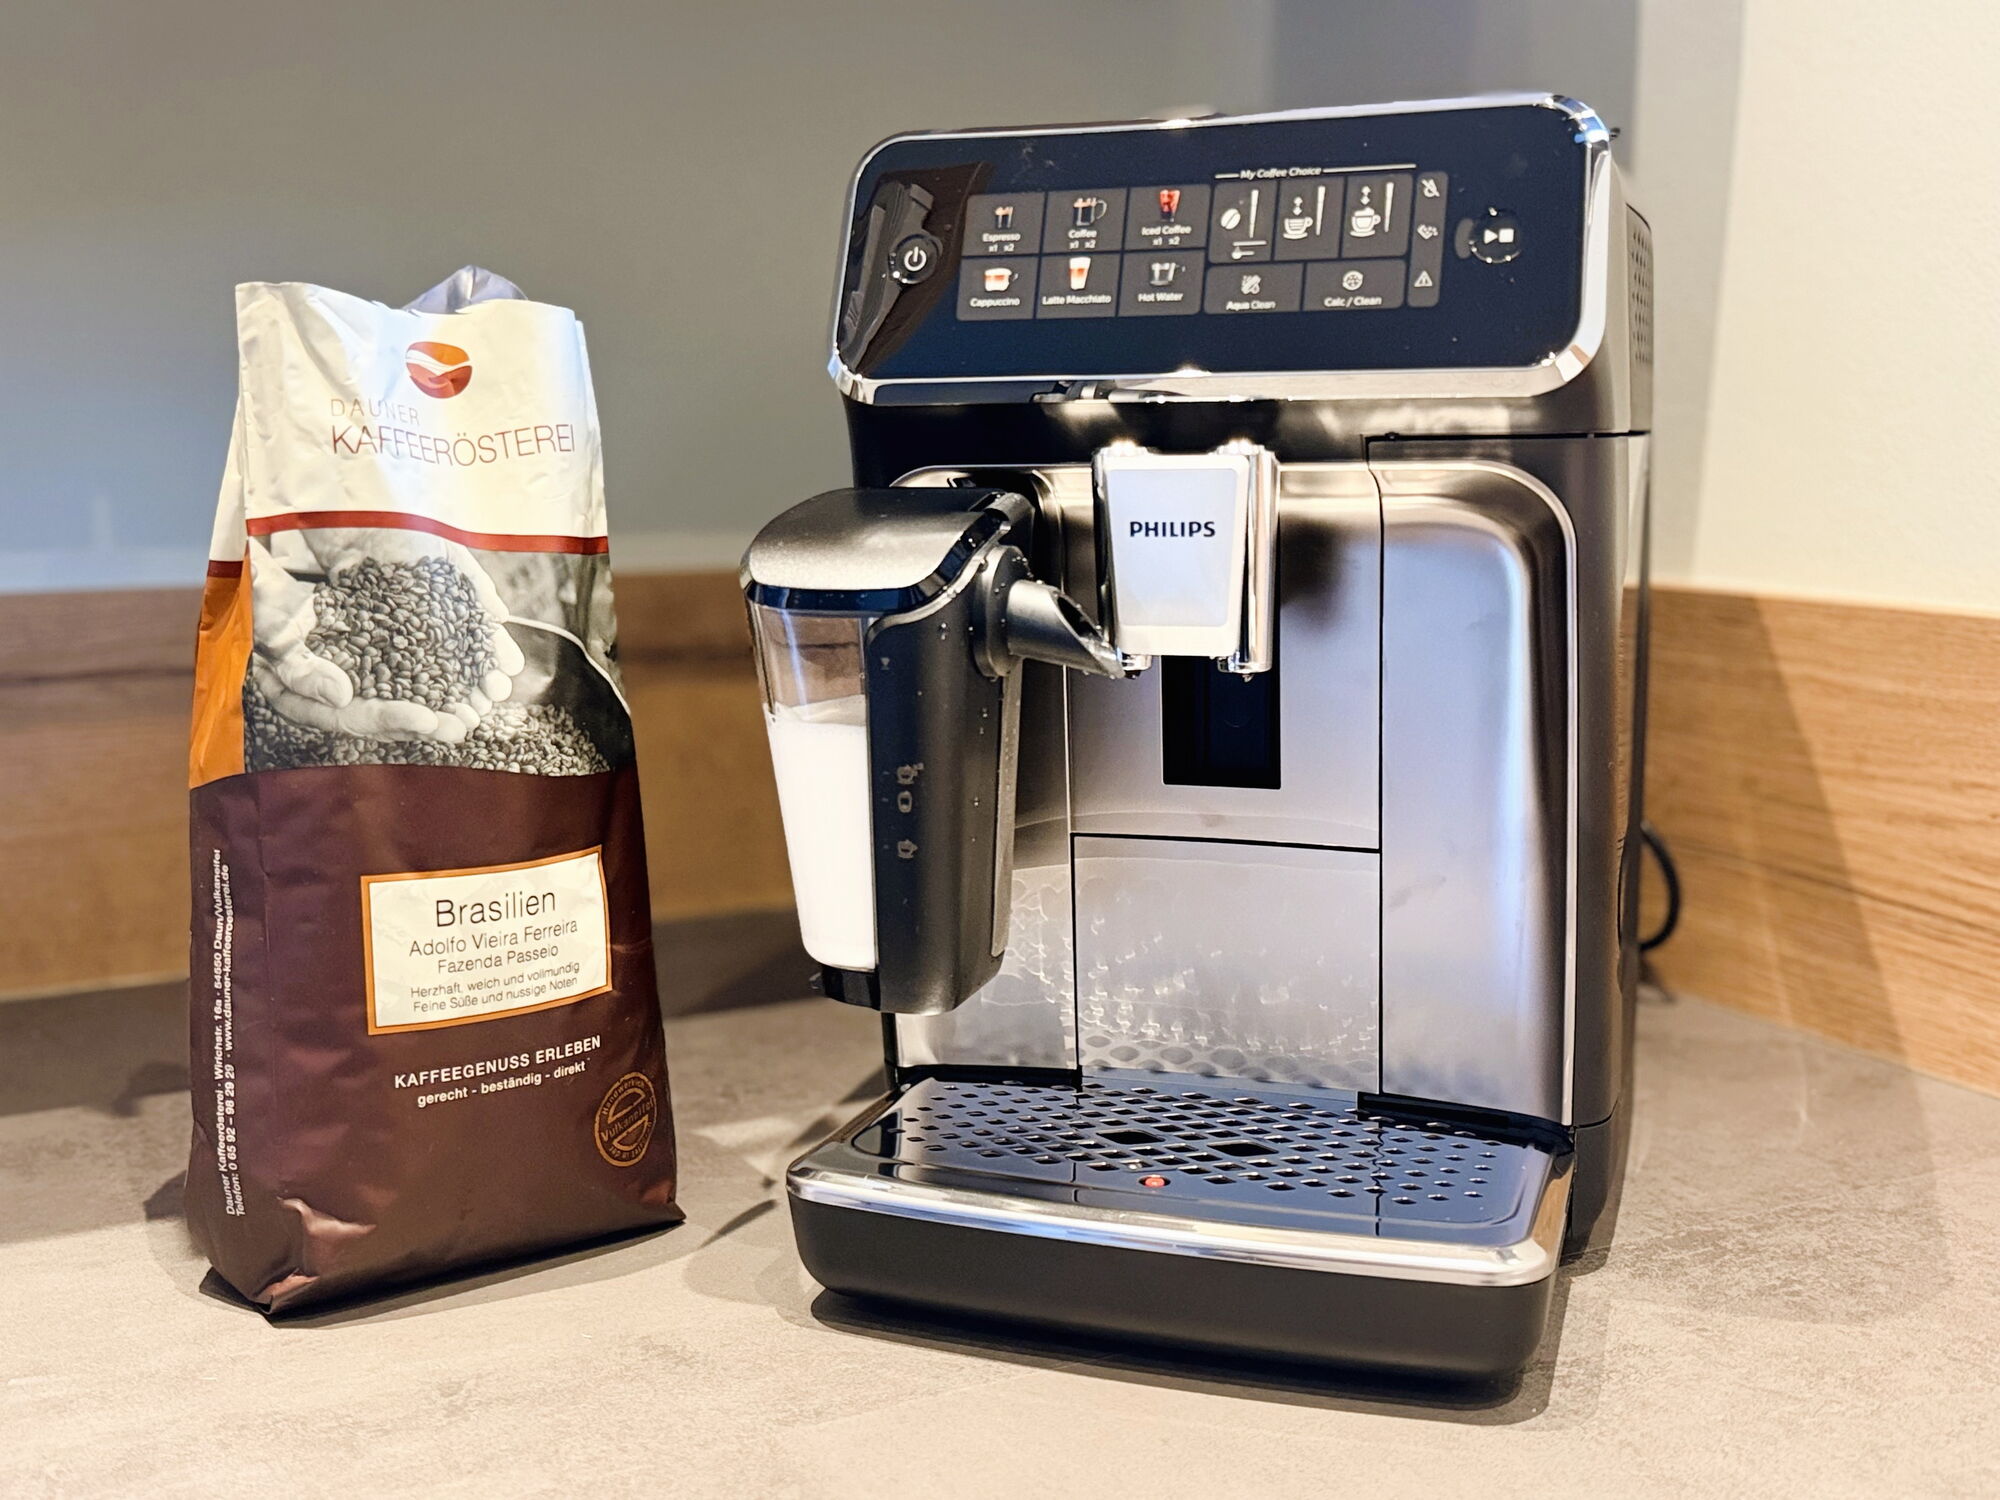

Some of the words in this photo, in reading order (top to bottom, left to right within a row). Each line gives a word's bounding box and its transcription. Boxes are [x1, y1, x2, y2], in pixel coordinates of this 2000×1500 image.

[1240, 169, 1256, 180] My
[1257, 168, 1288, 178] Coffee
[1288, 166, 1321, 177] Choice
[982, 231, 1021, 243] Espresso
[1068, 228, 1097, 239] Coffee
[1141, 225, 1156, 236] Iced
[1158, 224, 1191, 235] Coffee
[970, 296, 1020, 308] Cappuccino
[1042, 295, 1065, 305] Latte
[1067, 294, 1111, 304] Macchiato
[1138, 292, 1155, 302] Hot
[1156, 291, 1183, 302] Water
[1324, 296, 1345, 307] Calc
[1353, 295, 1382, 306] Clean
[1225, 300, 1250, 311] Aqua
[1251, 300, 1276, 310] Clean
[330, 398, 420, 426] DAUNER
[331, 424, 575, 467] KAFFEERÖSTEREI
[1130, 521, 1216, 538] PHILIPS
[436, 891, 556, 927] Brasilien
[409, 937, 466, 957] Adolfo
[471, 931, 519, 951] Vieira
[524, 919, 578, 943] Ferreira
[438, 954, 503, 974] Fazenda
[507, 944, 559, 963] Passeio
[214, 952, 223, 989] 54550
[468, 977, 501, 992] weich
[503, 973, 525, 987] und
[527, 961, 580, 982] vollmundig
[413, 1000, 447, 1013] Feine
[450, 995, 478, 1010] Süße
[481, 992, 503, 1005] und
[506, 984, 547, 1001] nussige
[549, 976, 578, 991] Noten
[394, 1053, 530, 1089] KAFFEEGENUSS
[535, 1035, 601, 1065] ERLEBEN
[225, 1063, 235, 1079] 29
[225, 1081, 235, 1097] 29
[417, 1086, 468, 1108] gerecht
[480, 1071, 542, 1095] beständig
[553, 1060, 586, 1079] direkt
[225, 1100, 235, 1115] 98
[214, 1089, 228, 1172] Kaffeerösterei
[226, 1127, 236, 1143] 92
[227, 1145, 237, 1160] 65
[228, 1161, 238, 1171] 0
[221, 1174, 235, 1215] Dauner
[231, 1173, 246, 1216] Telefon:
